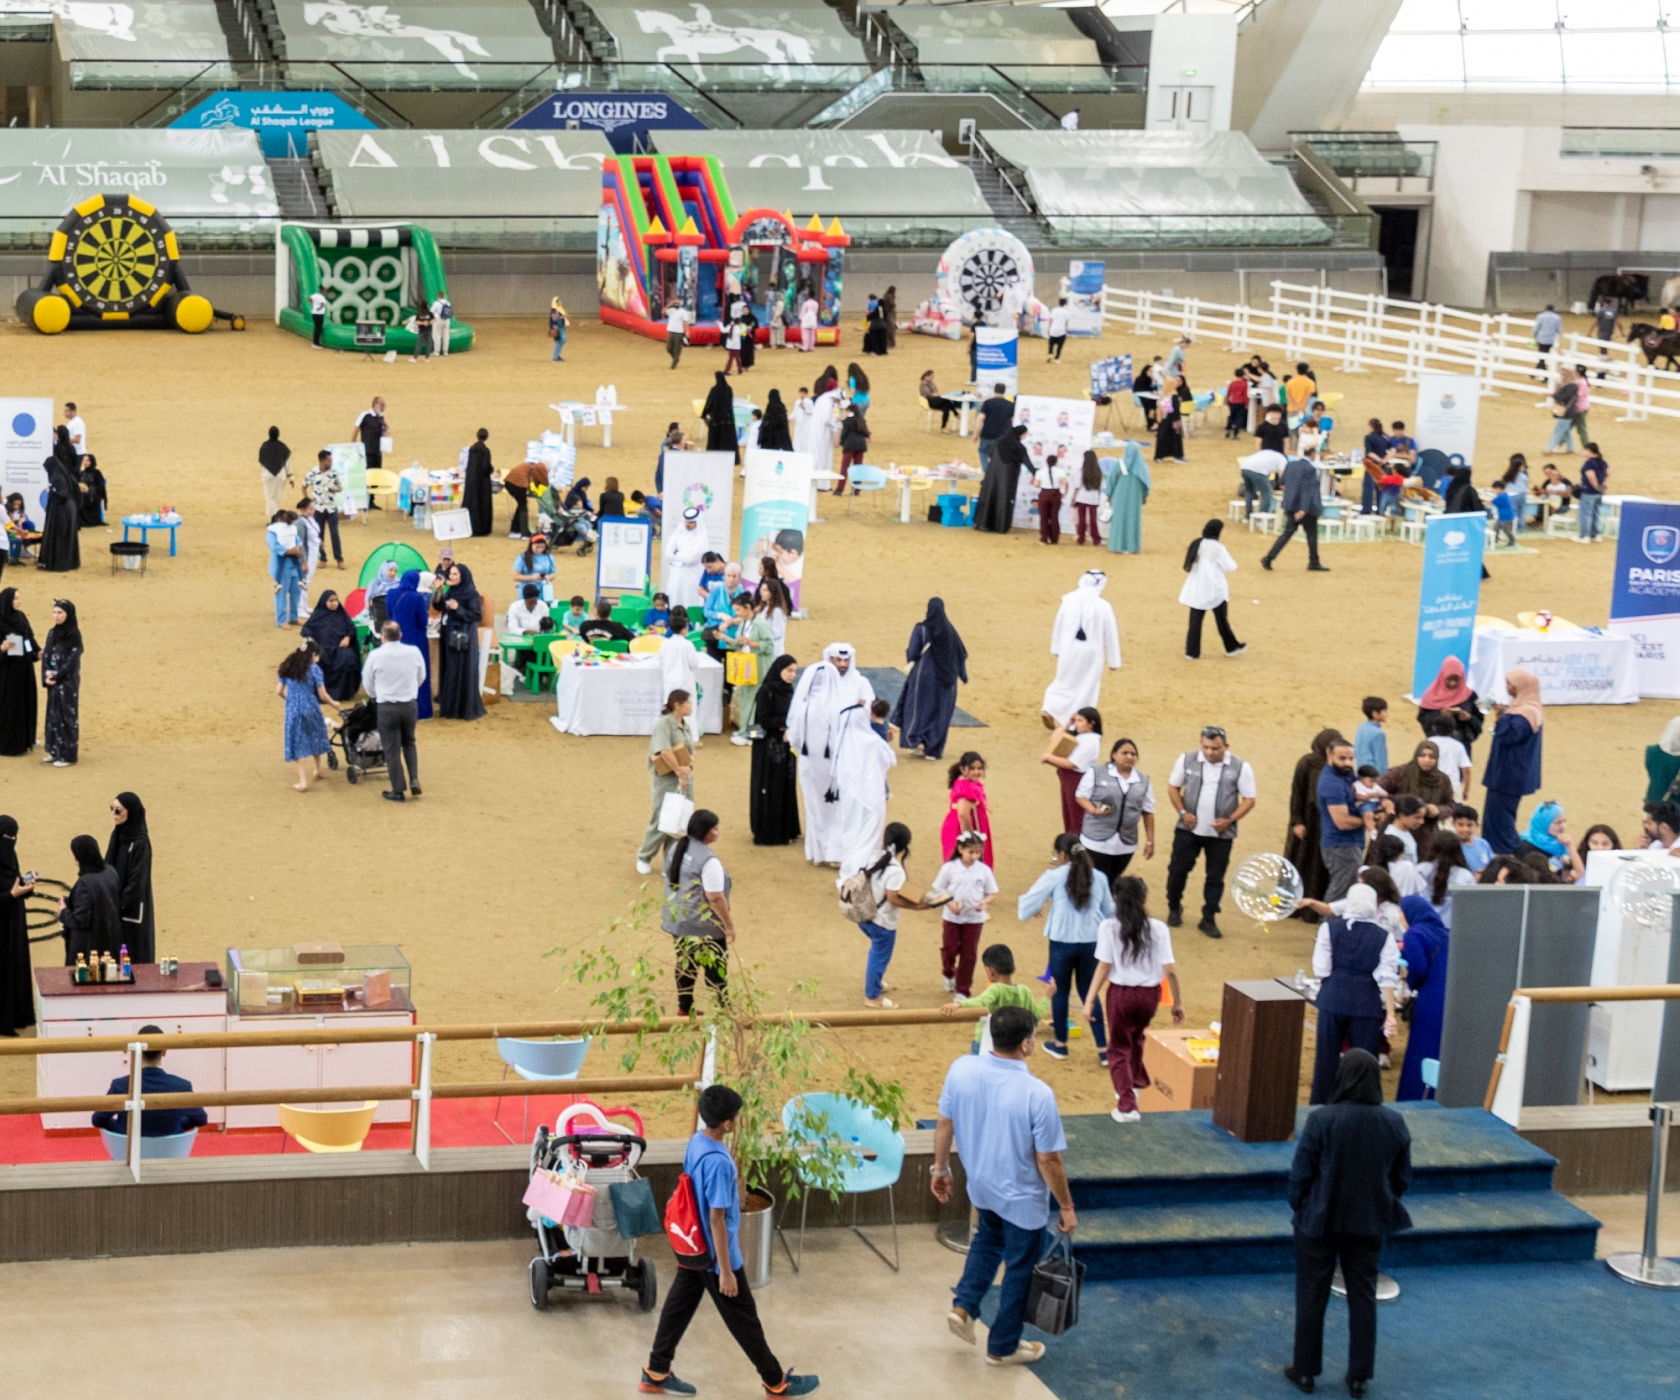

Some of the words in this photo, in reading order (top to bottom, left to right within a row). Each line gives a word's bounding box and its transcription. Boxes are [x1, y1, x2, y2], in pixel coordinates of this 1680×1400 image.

[552, 101, 667, 119] LONGINES
[250, 116, 260, 126] Al
[261, 116, 298, 127] Shaqab
[299, 117, 334, 128] League
[37, 165, 68, 186] Al
[75, 165, 167, 191] Shaqab
[1629, 567, 1680, 583] PARIS
[1564, 652, 1600, 665] ABILITY
[1568, 679, 1614, 691] PROGRAM
